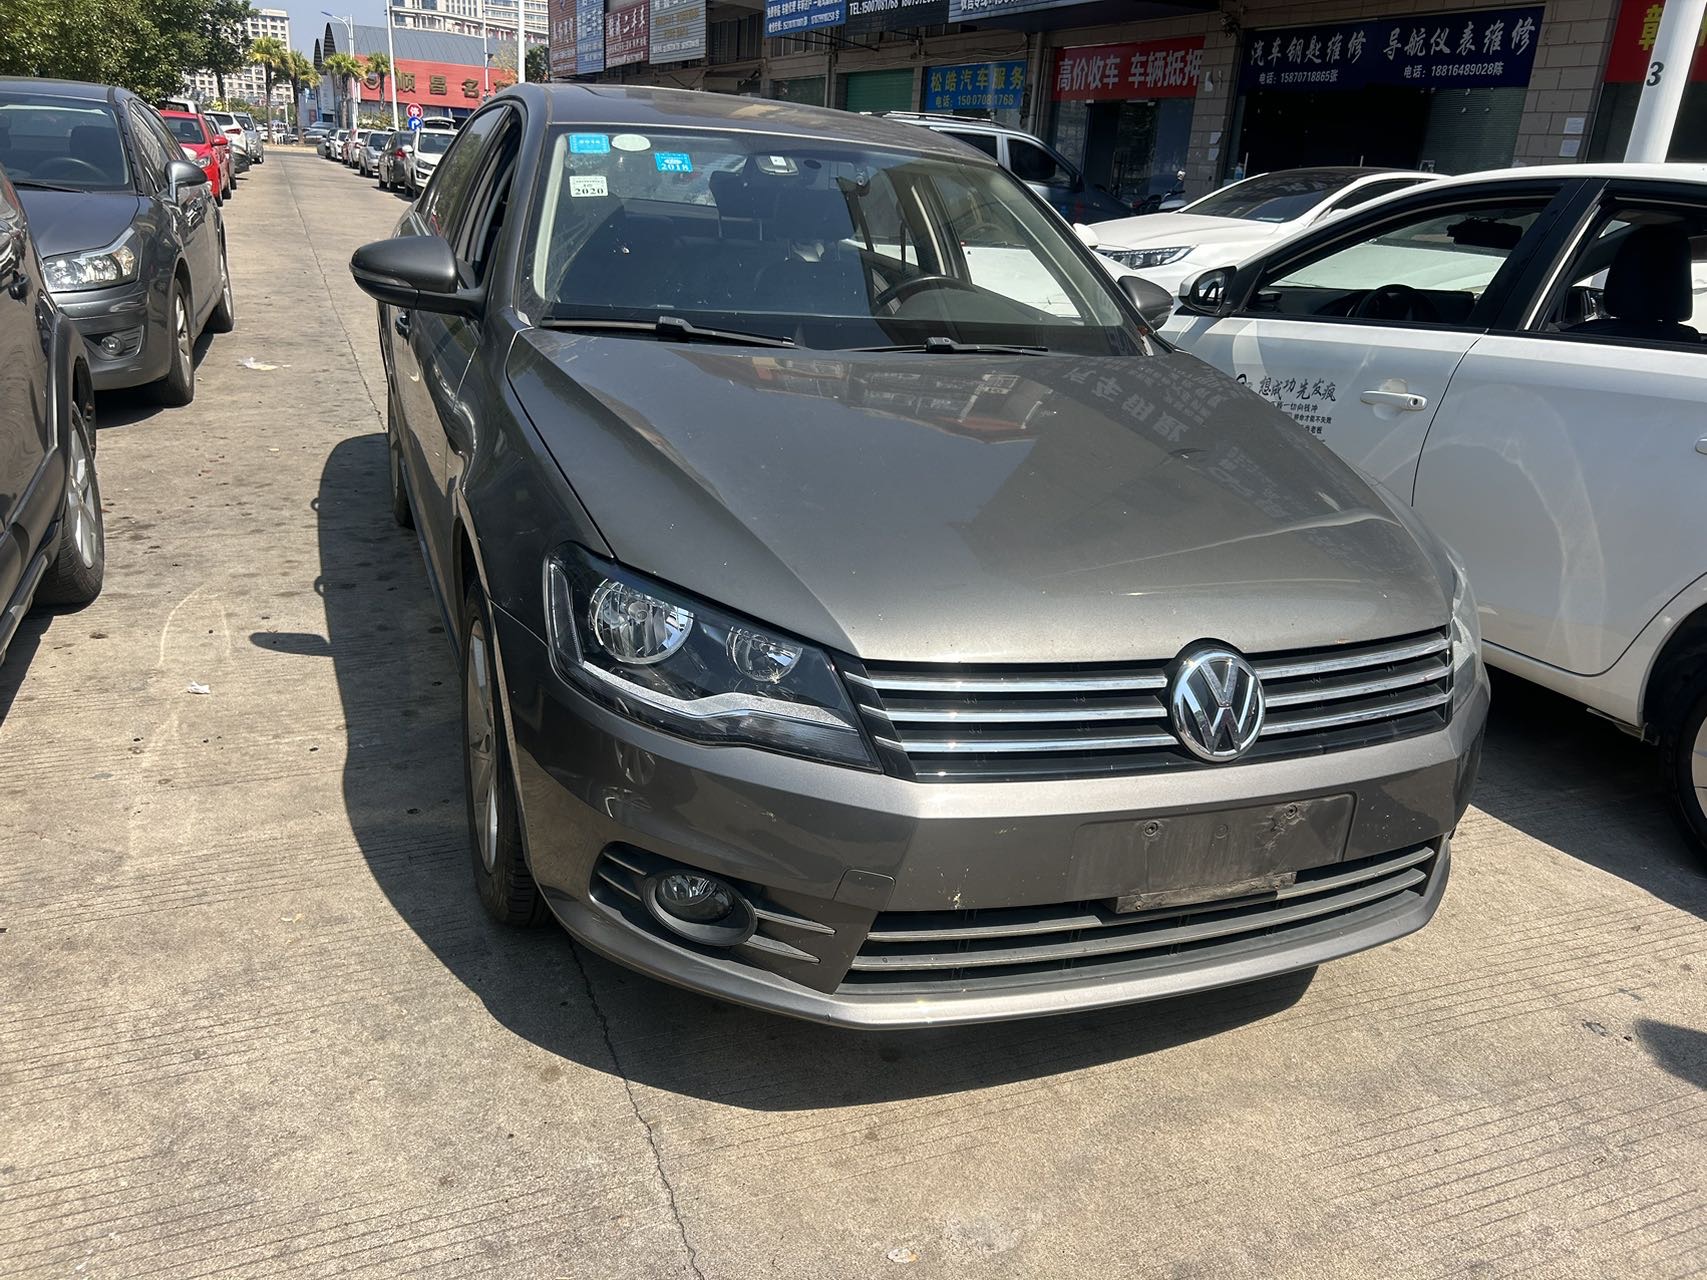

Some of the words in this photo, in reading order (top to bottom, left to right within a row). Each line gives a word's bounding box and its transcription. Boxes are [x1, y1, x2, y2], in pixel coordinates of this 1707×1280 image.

[1250, 29, 1366, 67] 汽车钥匙维修
[1383, 17, 1536, 61] 导航仪表维修
[1056, 54, 1121, 91] 高价收车
[1128, 48, 1202, 88] 车辆抵押
[1646, 61, 1664, 87] 3
[575, 188, 604, 196] 2020
[1259, 376, 1336, 402] 想成功先发疯
